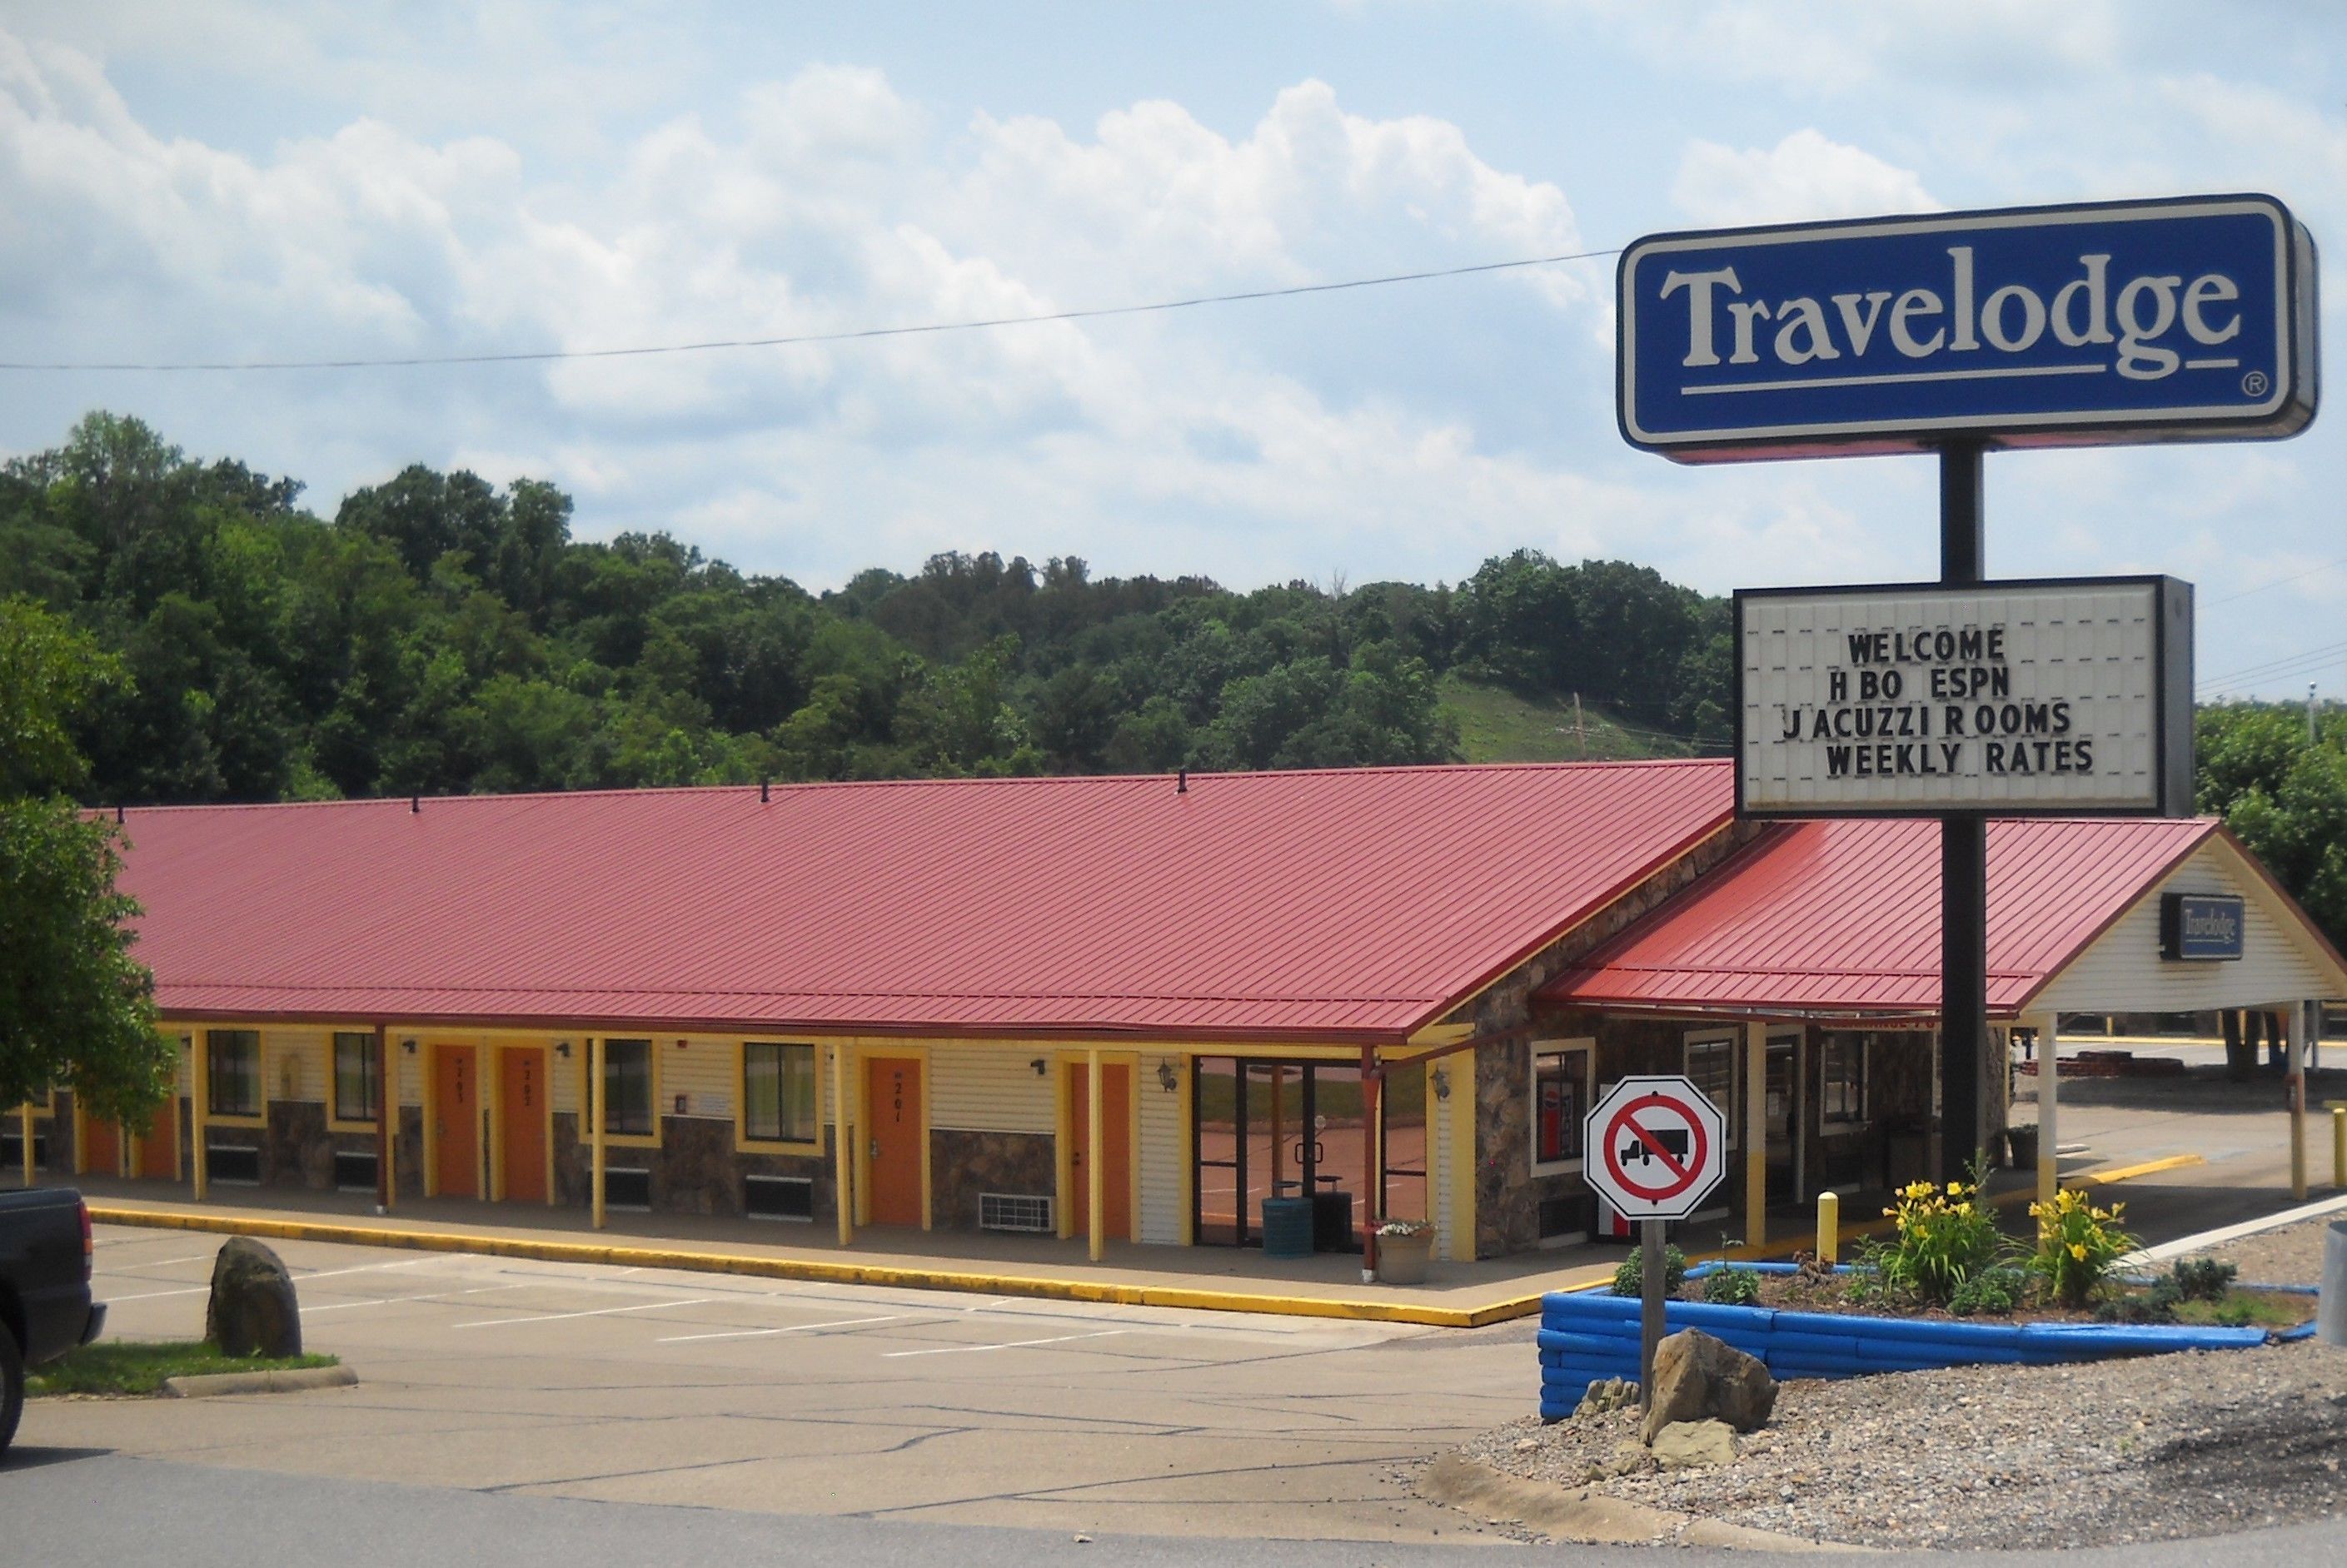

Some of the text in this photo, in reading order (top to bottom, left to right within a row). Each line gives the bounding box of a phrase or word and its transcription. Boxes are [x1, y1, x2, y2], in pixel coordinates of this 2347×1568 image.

[1660, 246, 2240, 380] Travelodge
[1848, 630, 2006, 664] WELCOME
[1830, 667, 2009, 701] HBO ESPN
[1783, 703, 2070, 739] JACUZZI ROOMS
[1826, 740, 2093, 774] WEEKLY RATES
